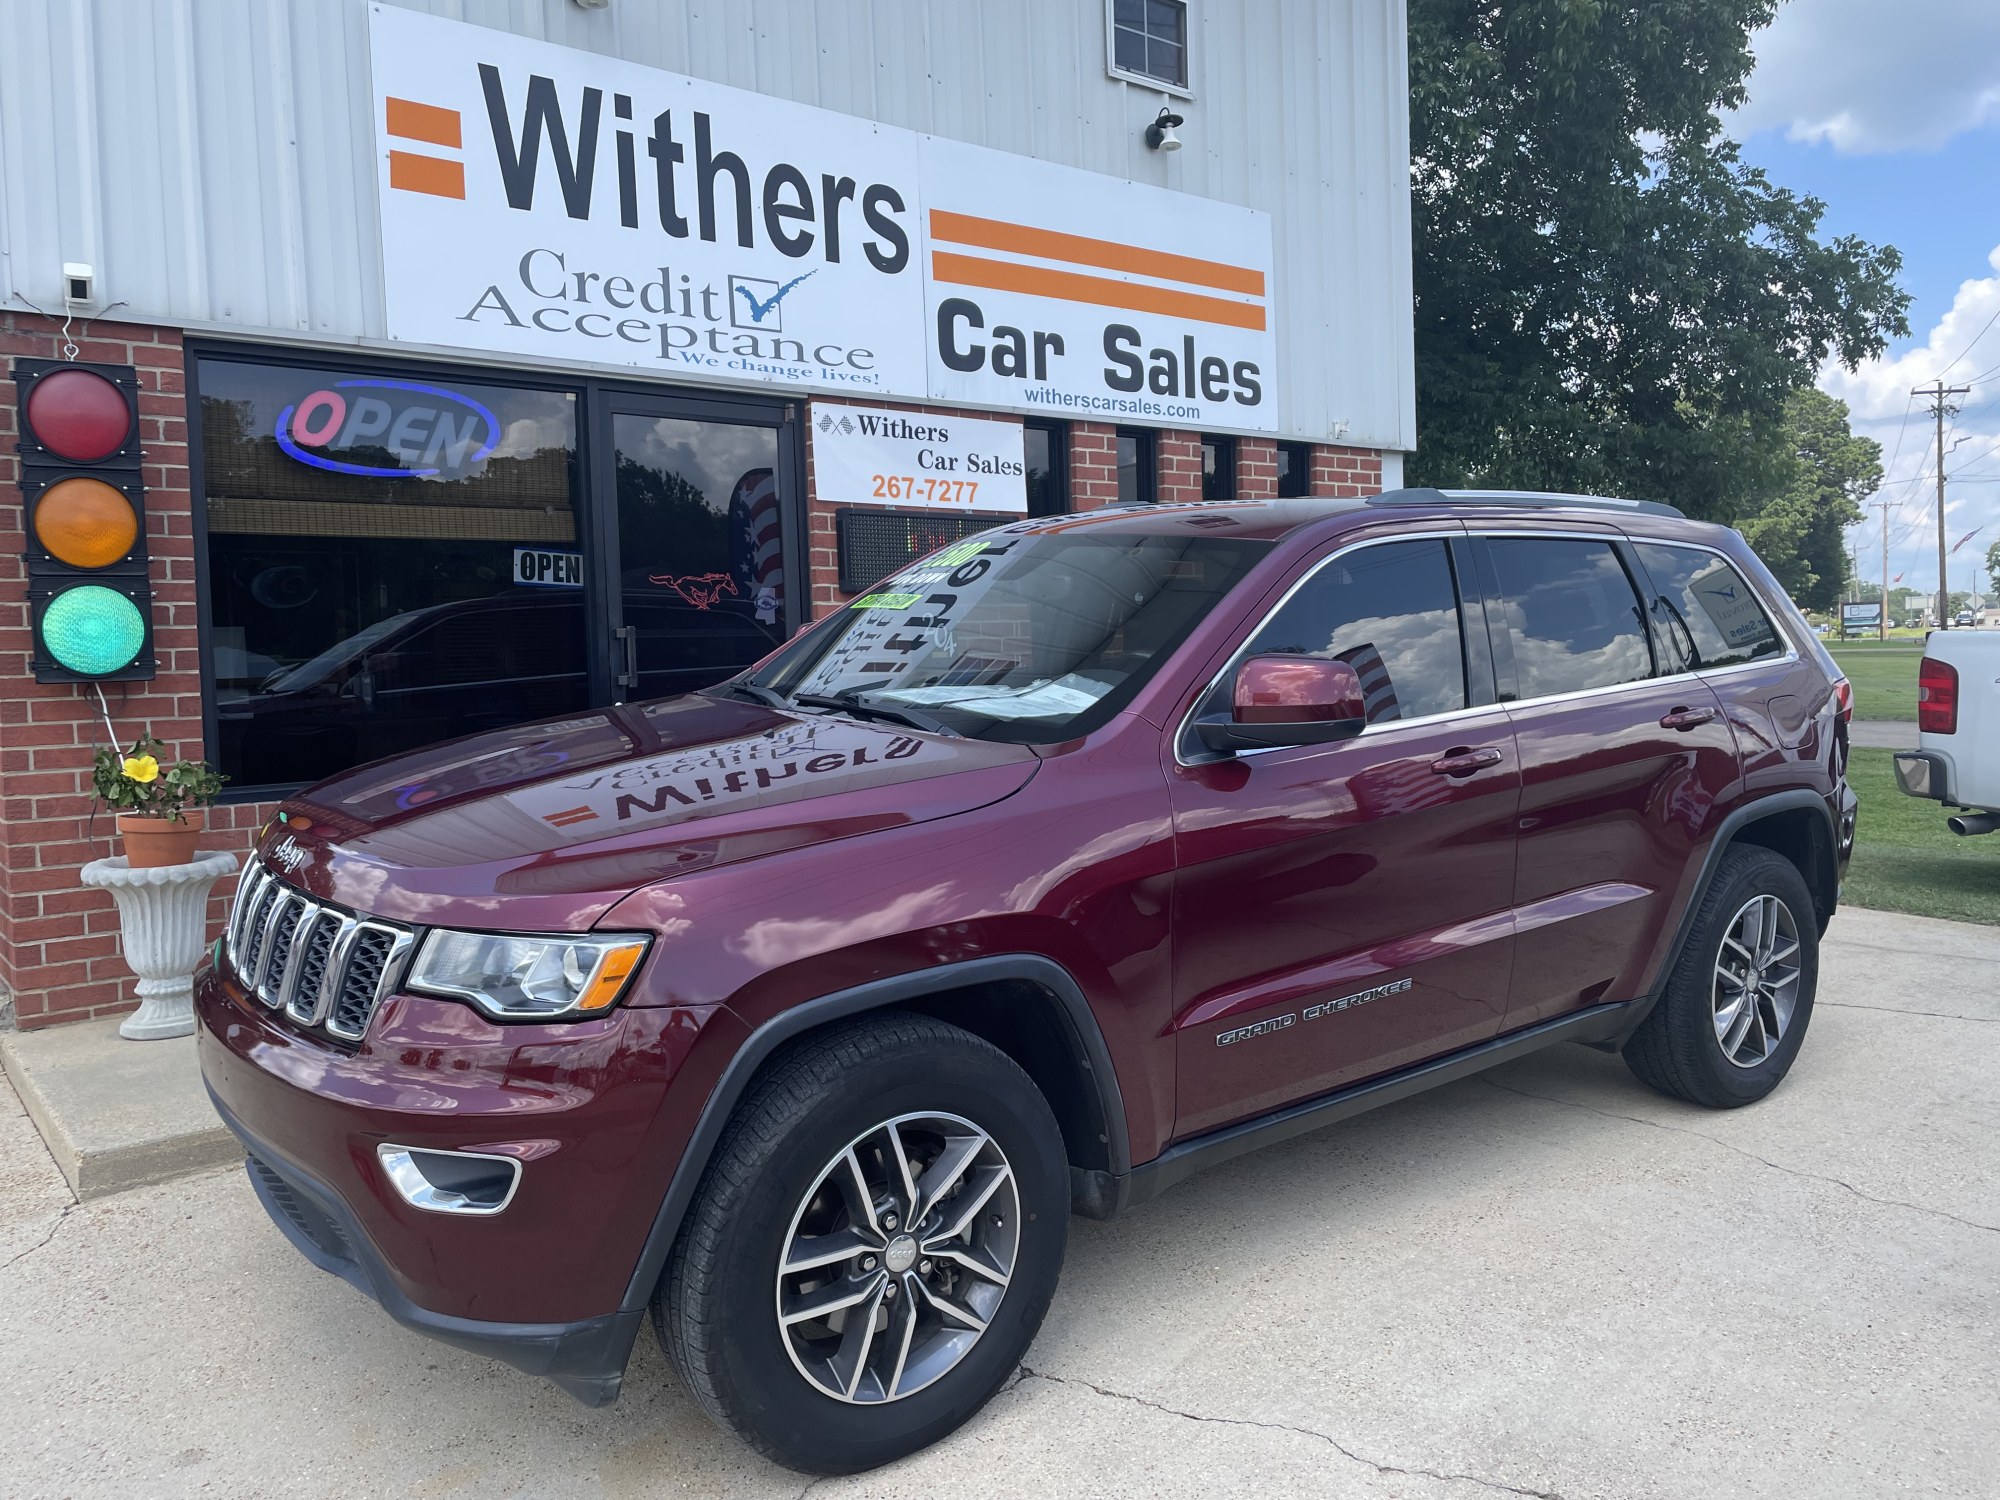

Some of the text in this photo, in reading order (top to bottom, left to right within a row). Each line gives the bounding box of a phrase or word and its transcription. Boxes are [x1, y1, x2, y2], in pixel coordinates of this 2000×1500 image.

[477, 62, 910, 275] Withers
[518, 248, 723, 322] Credit
[456, 284, 875, 371] Acceptance
[680, 351, 880, 385] We change lives!
[937, 298, 1262, 406] Car Sales
[1024, 386, 1201, 420] witherscarsales.com
[292, 389, 480, 469] OPEN
[857, 414, 949, 443] Withers
[917, 449, 1023, 476] Car Sales
[872, 474, 978, 504] 267-7277
[521, 552, 580, 584] OPEN
[922, 612, 958, 658] 204
[1216, 977, 1413, 1047] GRAND CHEROKEE
